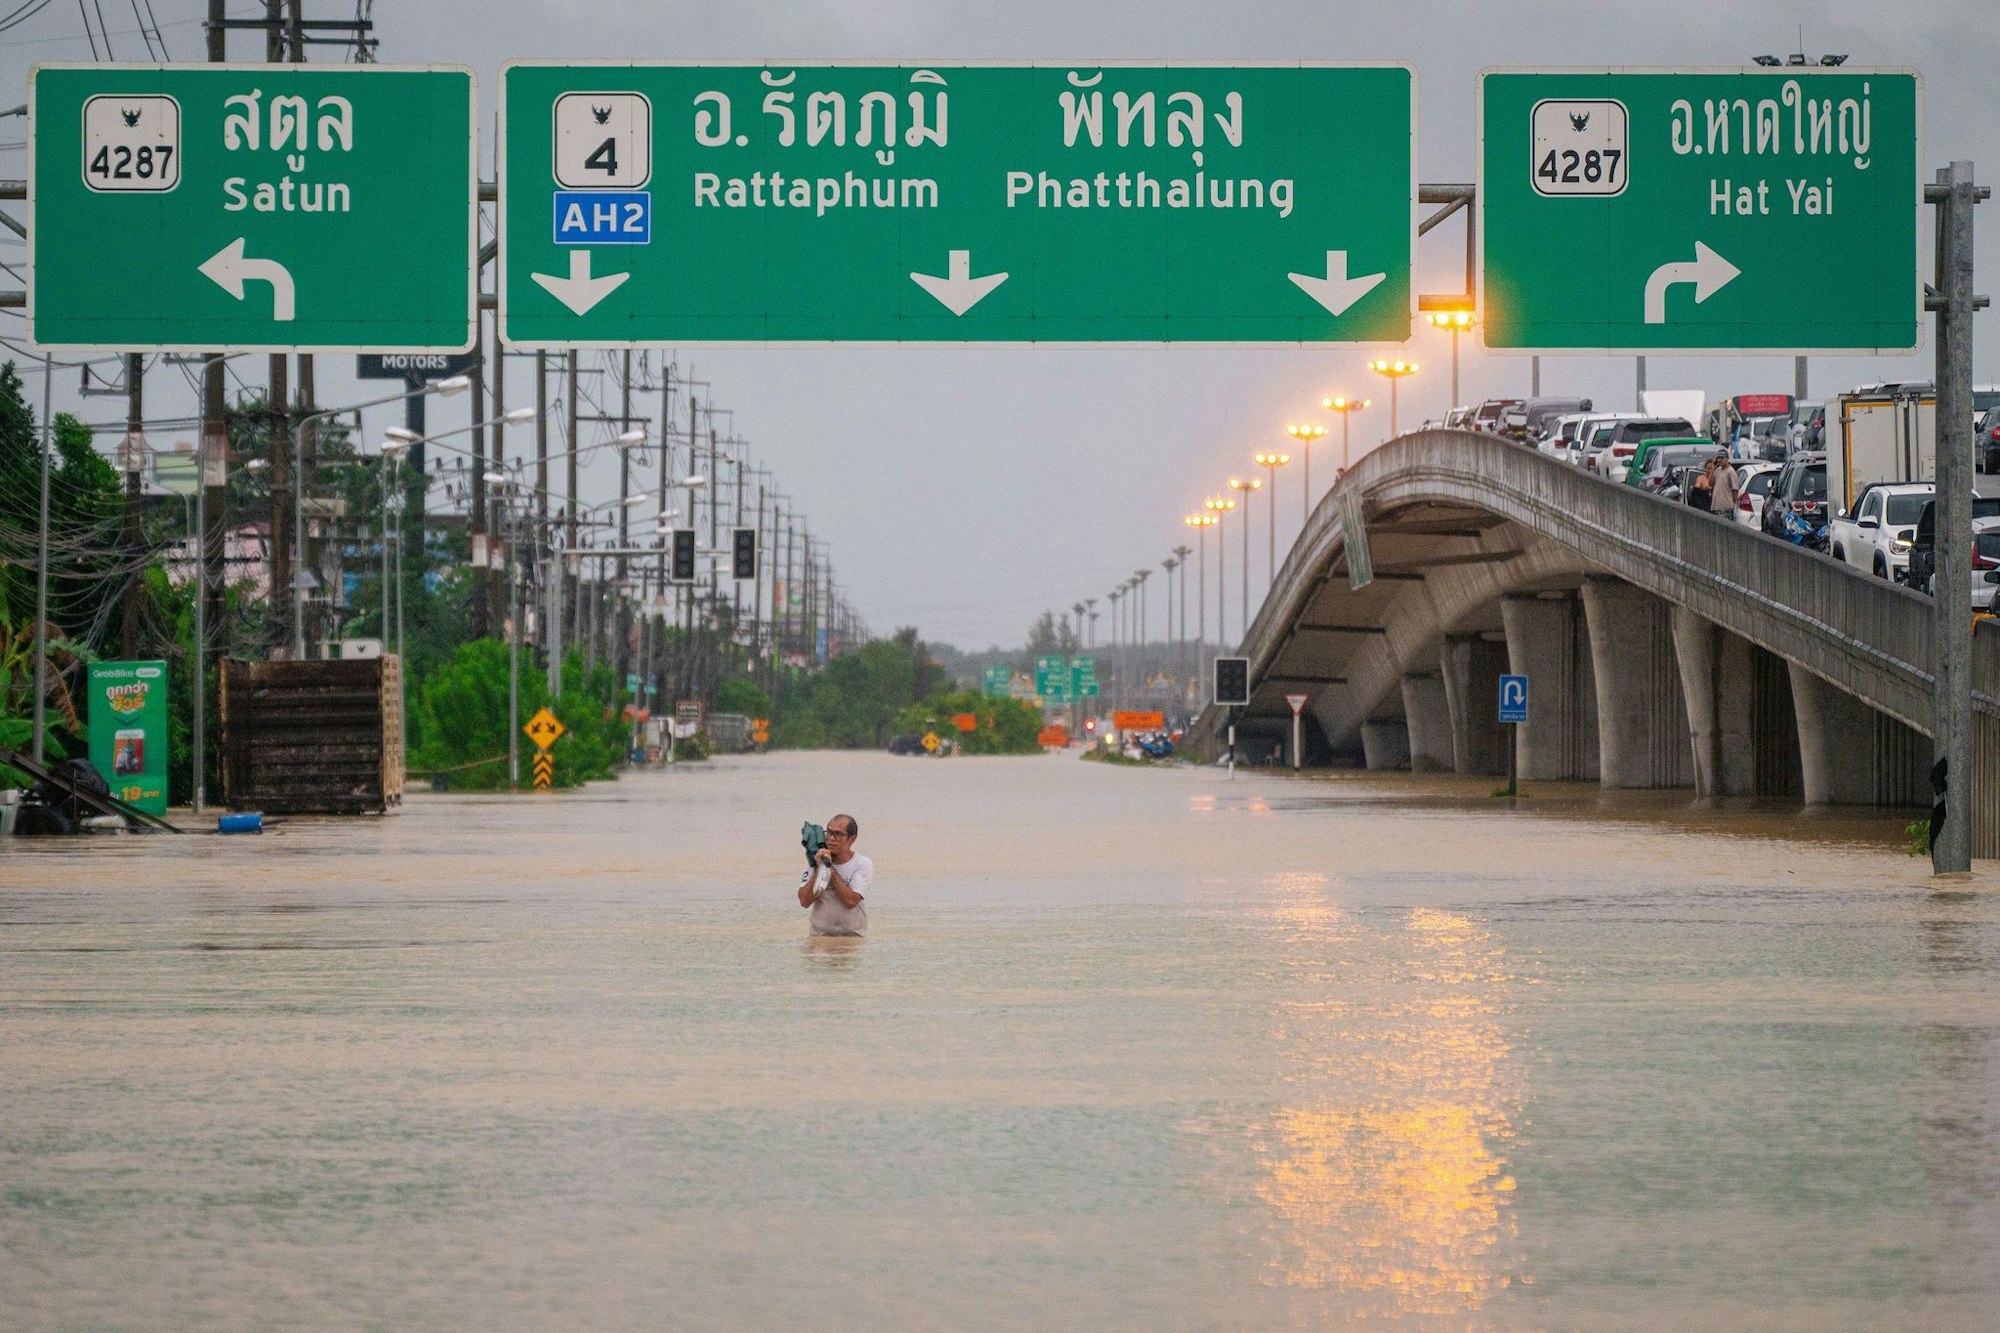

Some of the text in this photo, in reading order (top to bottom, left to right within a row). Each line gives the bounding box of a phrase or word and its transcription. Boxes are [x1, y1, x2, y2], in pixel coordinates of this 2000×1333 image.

[224, 88, 353, 172] สตูล
[694, 70, 949, 165] อ. รัตภูมิ
[1058, 71, 1243, 167] พัทลุง
[1671, 80, 1871, 169] อ.หาดใหญ่
[90, 145, 173, 179] 4287
[584, 137, 618, 176] 4
[1538, 149, 1621, 183] 4287
[224, 175, 350, 212] Satun
[694, 170, 938, 217] Rattaphum
[1007, 171, 1294, 219] Phatthalung
[1711, 177, 1833, 215] Hat Yai
[561, 202, 644, 233] AH2
[382, 355, 447, 369] MOTORS
[93, 669, 134, 678] GrabBike
[121, 786, 142, 801] 19
